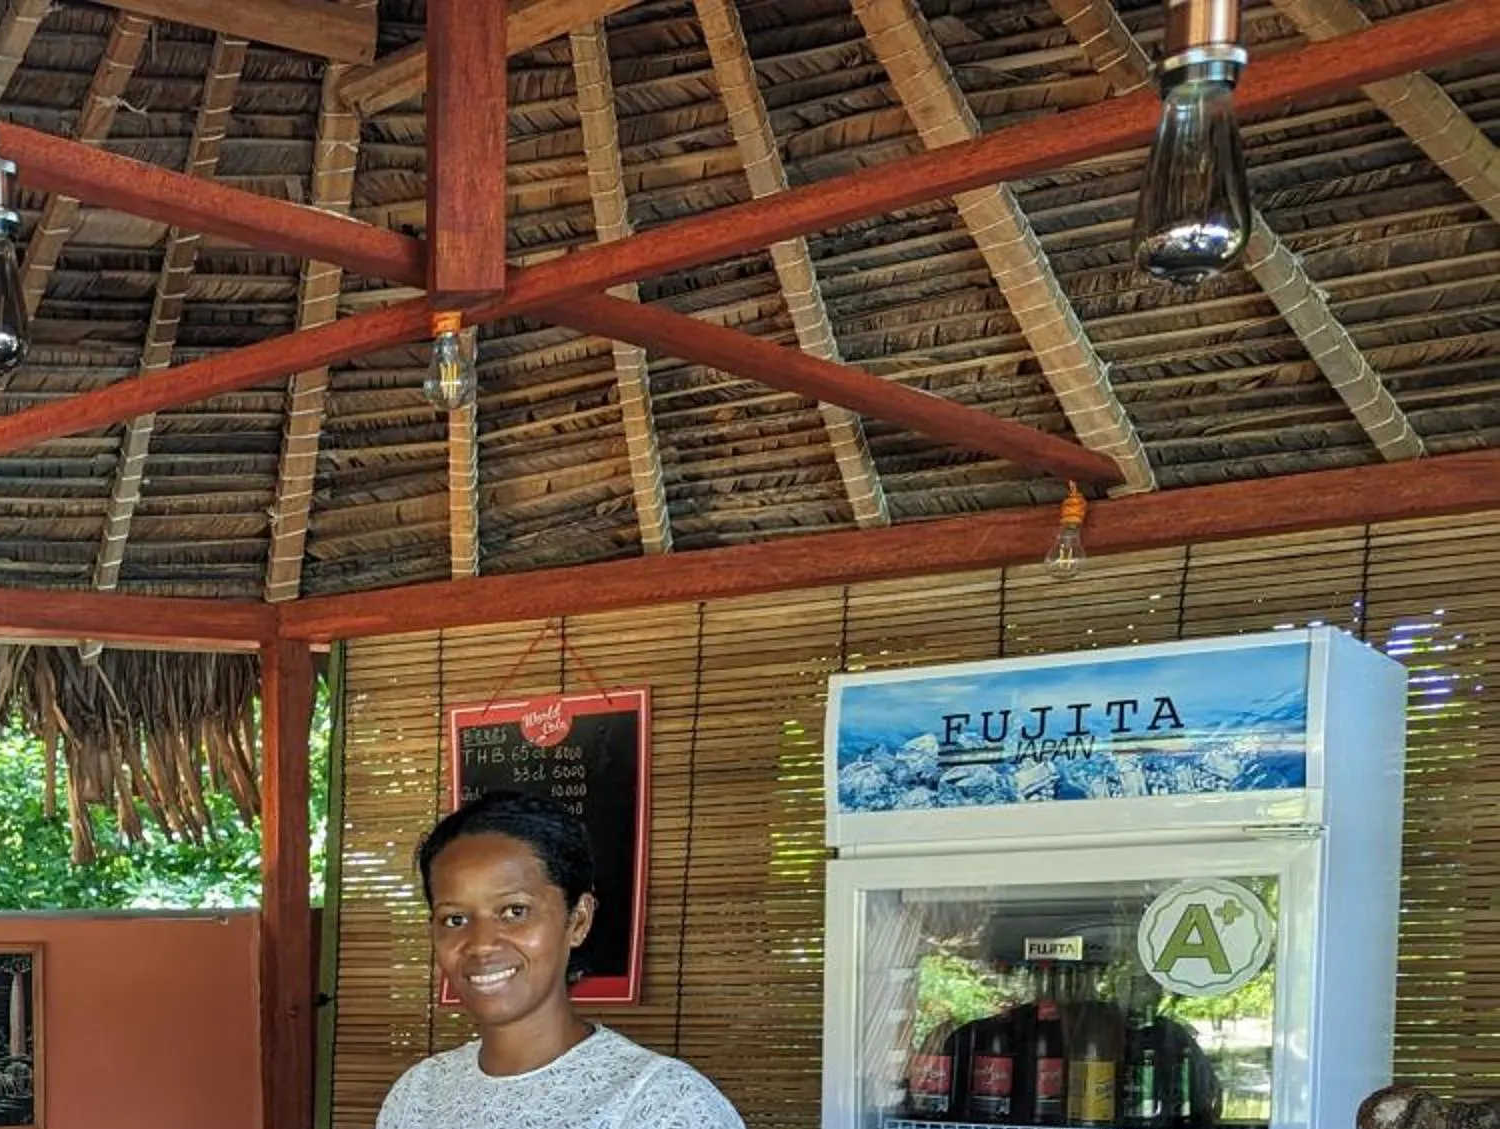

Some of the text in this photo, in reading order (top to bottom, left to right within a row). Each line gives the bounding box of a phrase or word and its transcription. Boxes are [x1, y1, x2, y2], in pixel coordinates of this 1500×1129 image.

[522, 703, 561, 727] World
[543, 719, 566, 735] Cola
[941, 696, 1184, 747] FUJITA
[462, 747, 505, 765] THB
[1015, 736, 1095, 763] JAPAN
